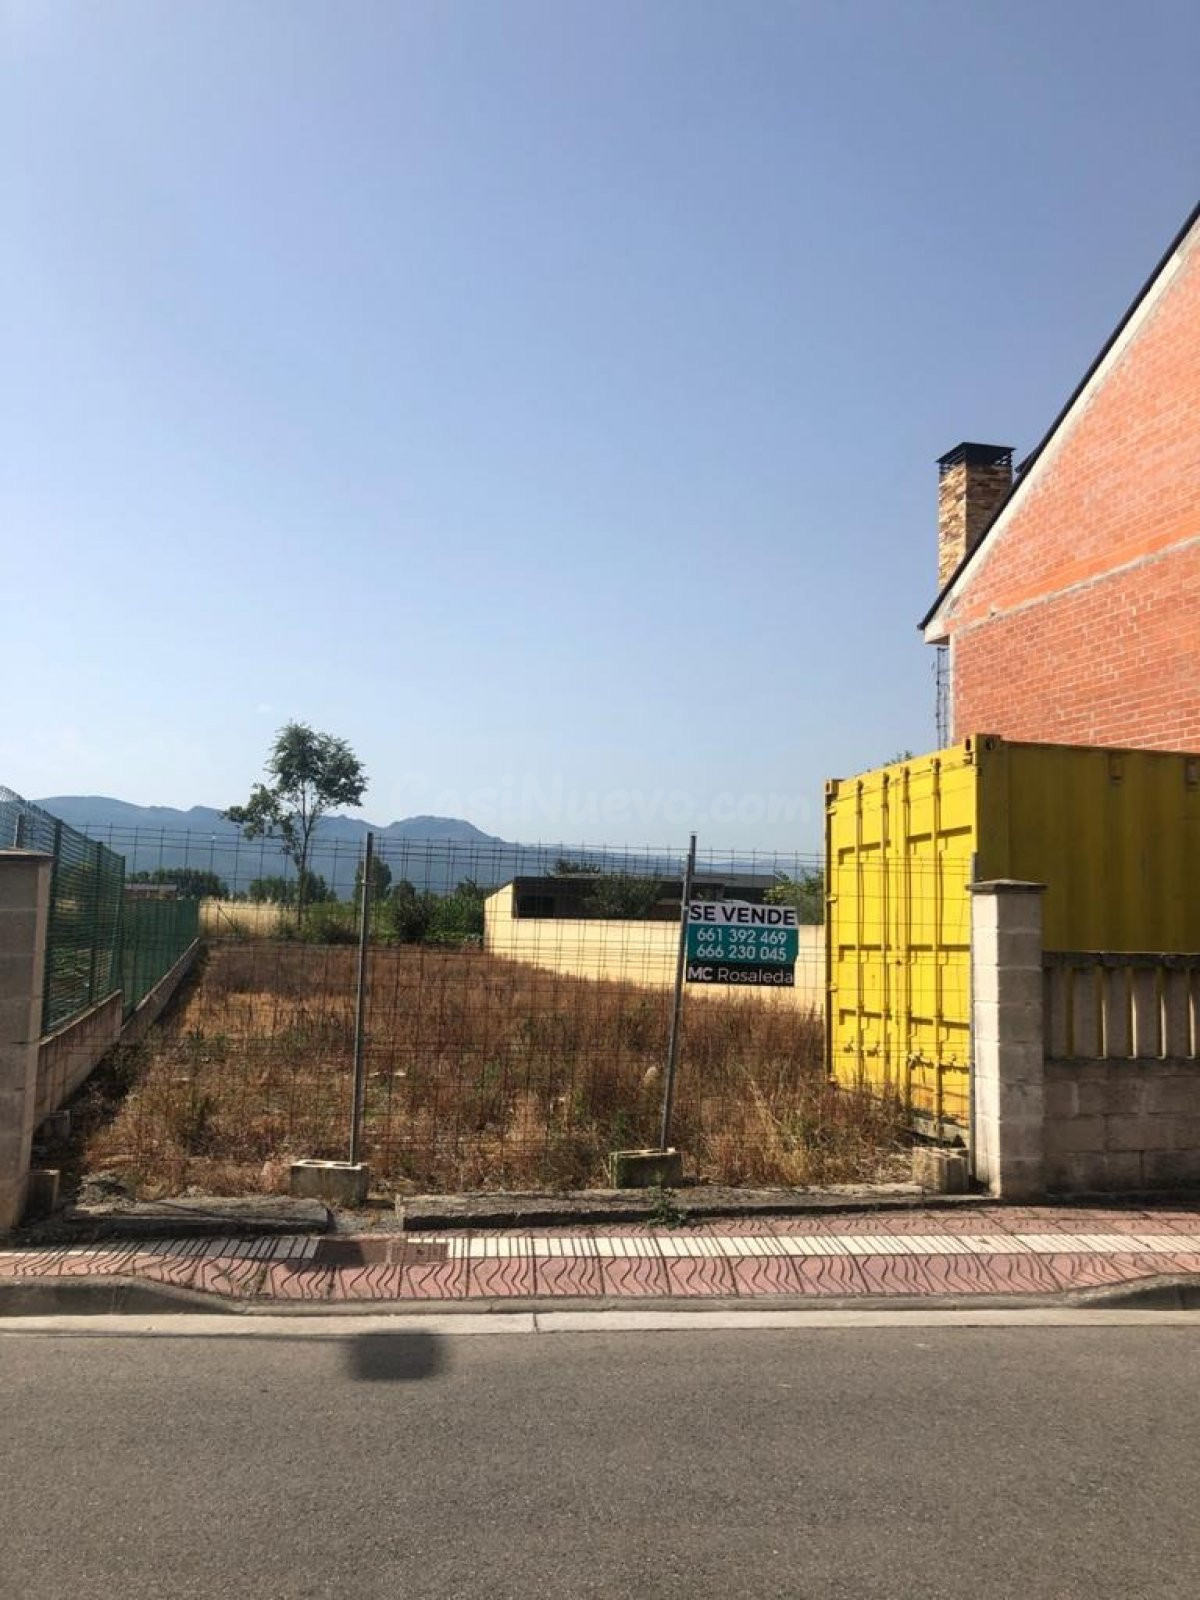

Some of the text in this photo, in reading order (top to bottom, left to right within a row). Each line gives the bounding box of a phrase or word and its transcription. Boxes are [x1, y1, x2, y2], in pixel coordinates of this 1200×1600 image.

[690, 905, 796, 926] SE VENDE
[697, 928, 787, 945] 661 392 469
[696, 943, 787, 962] 666 230 045
[687, 966, 793, 984] MC Rosaleda
